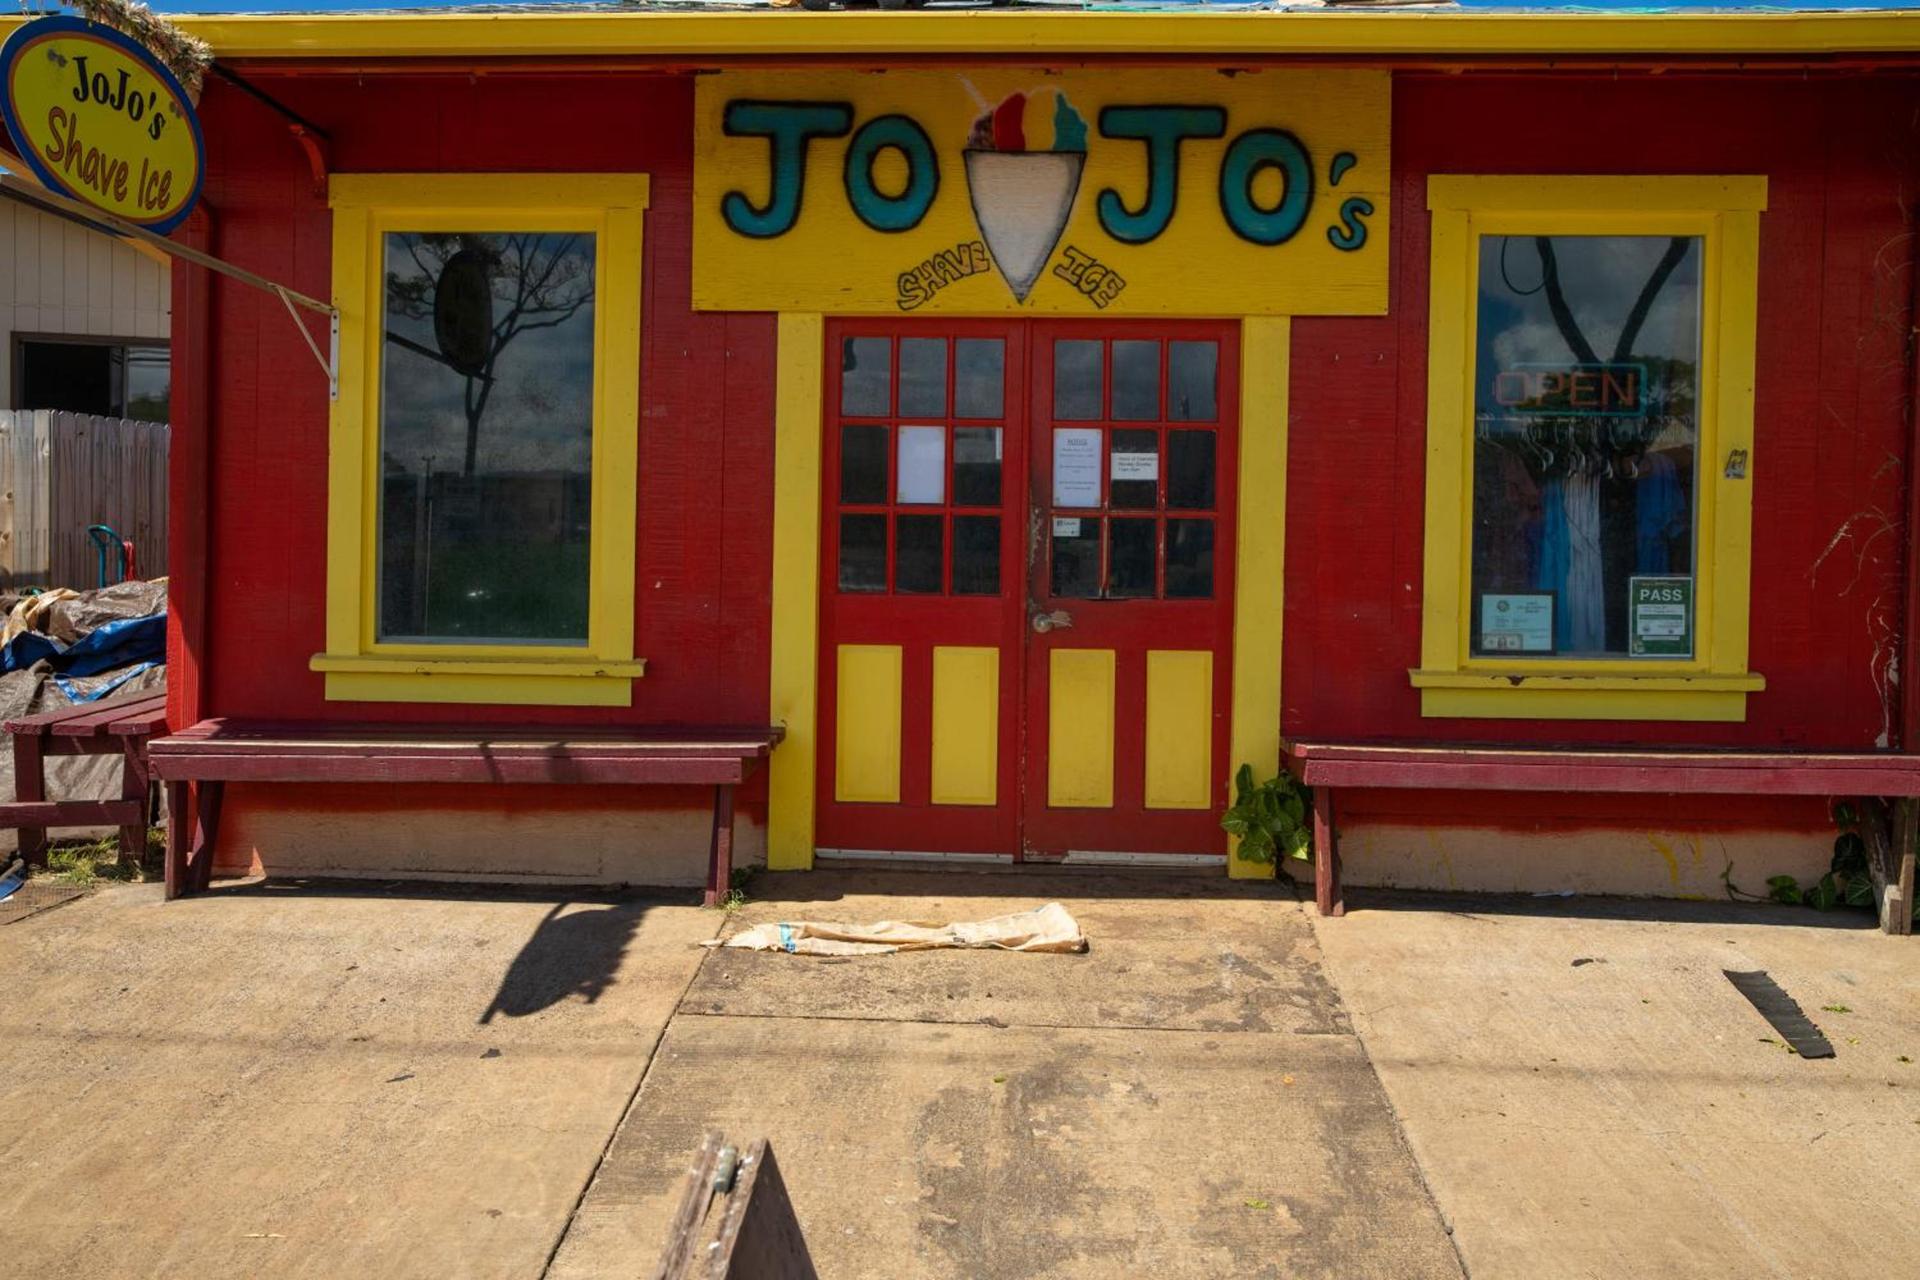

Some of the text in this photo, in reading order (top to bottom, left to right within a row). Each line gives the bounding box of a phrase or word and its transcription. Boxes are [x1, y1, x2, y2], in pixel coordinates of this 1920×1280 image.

[72, 56, 166, 140] JoJo's
[46, 106, 173, 210] Shave Ice
[720, 99, 941, 239] JO
[897, 240, 1127, 310] SHAVE ICE
[1494, 370, 1638, 408] OPEN
[1639, 588, 1683, 602] PASS
